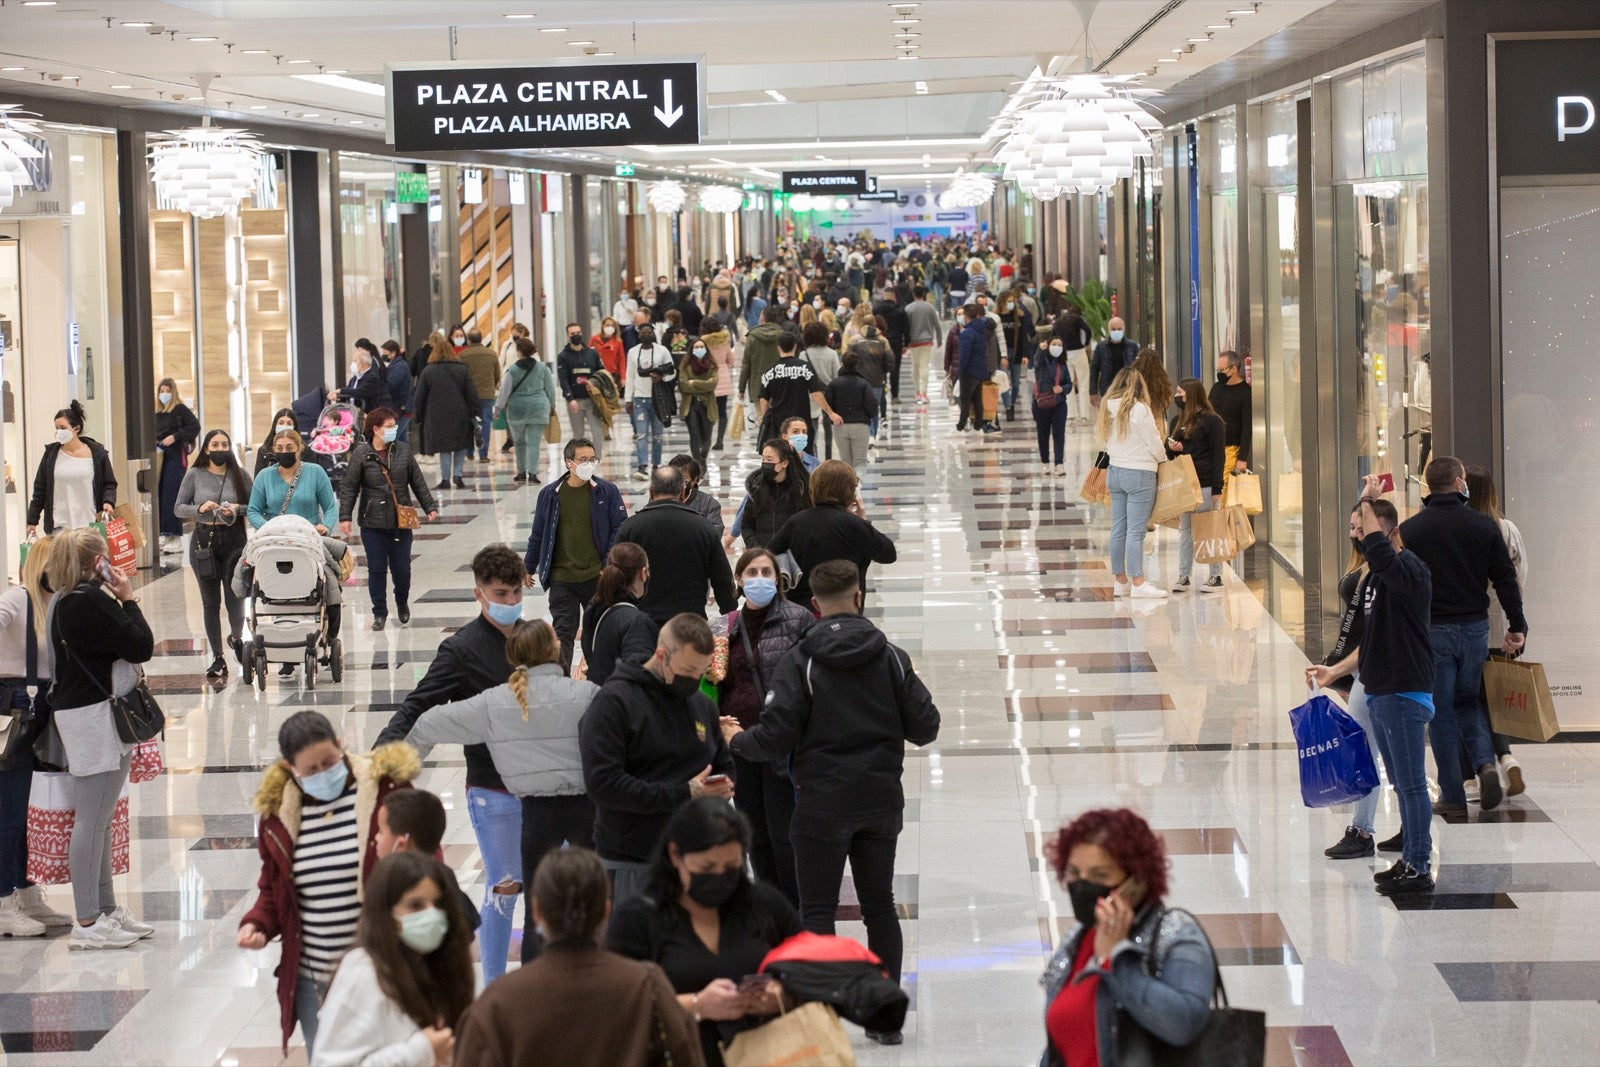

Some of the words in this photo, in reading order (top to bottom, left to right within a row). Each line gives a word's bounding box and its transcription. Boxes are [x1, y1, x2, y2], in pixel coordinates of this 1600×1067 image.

[417, 83, 508, 105] PLAZA
[517, 79, 648, 102] CENTRAL
[434, 115, 504, 134] PLAZA
[508, 112, 631, 132] ALHAMBRA
[1558, 96, 1595, 142] P
[790, 177, 818, 186] PLAZA
[819, 176, 858, 186] CENTRAL
[1335, 636, 1347, 656] IMBA
[1342, 609, 1356, 633] BIMBA
